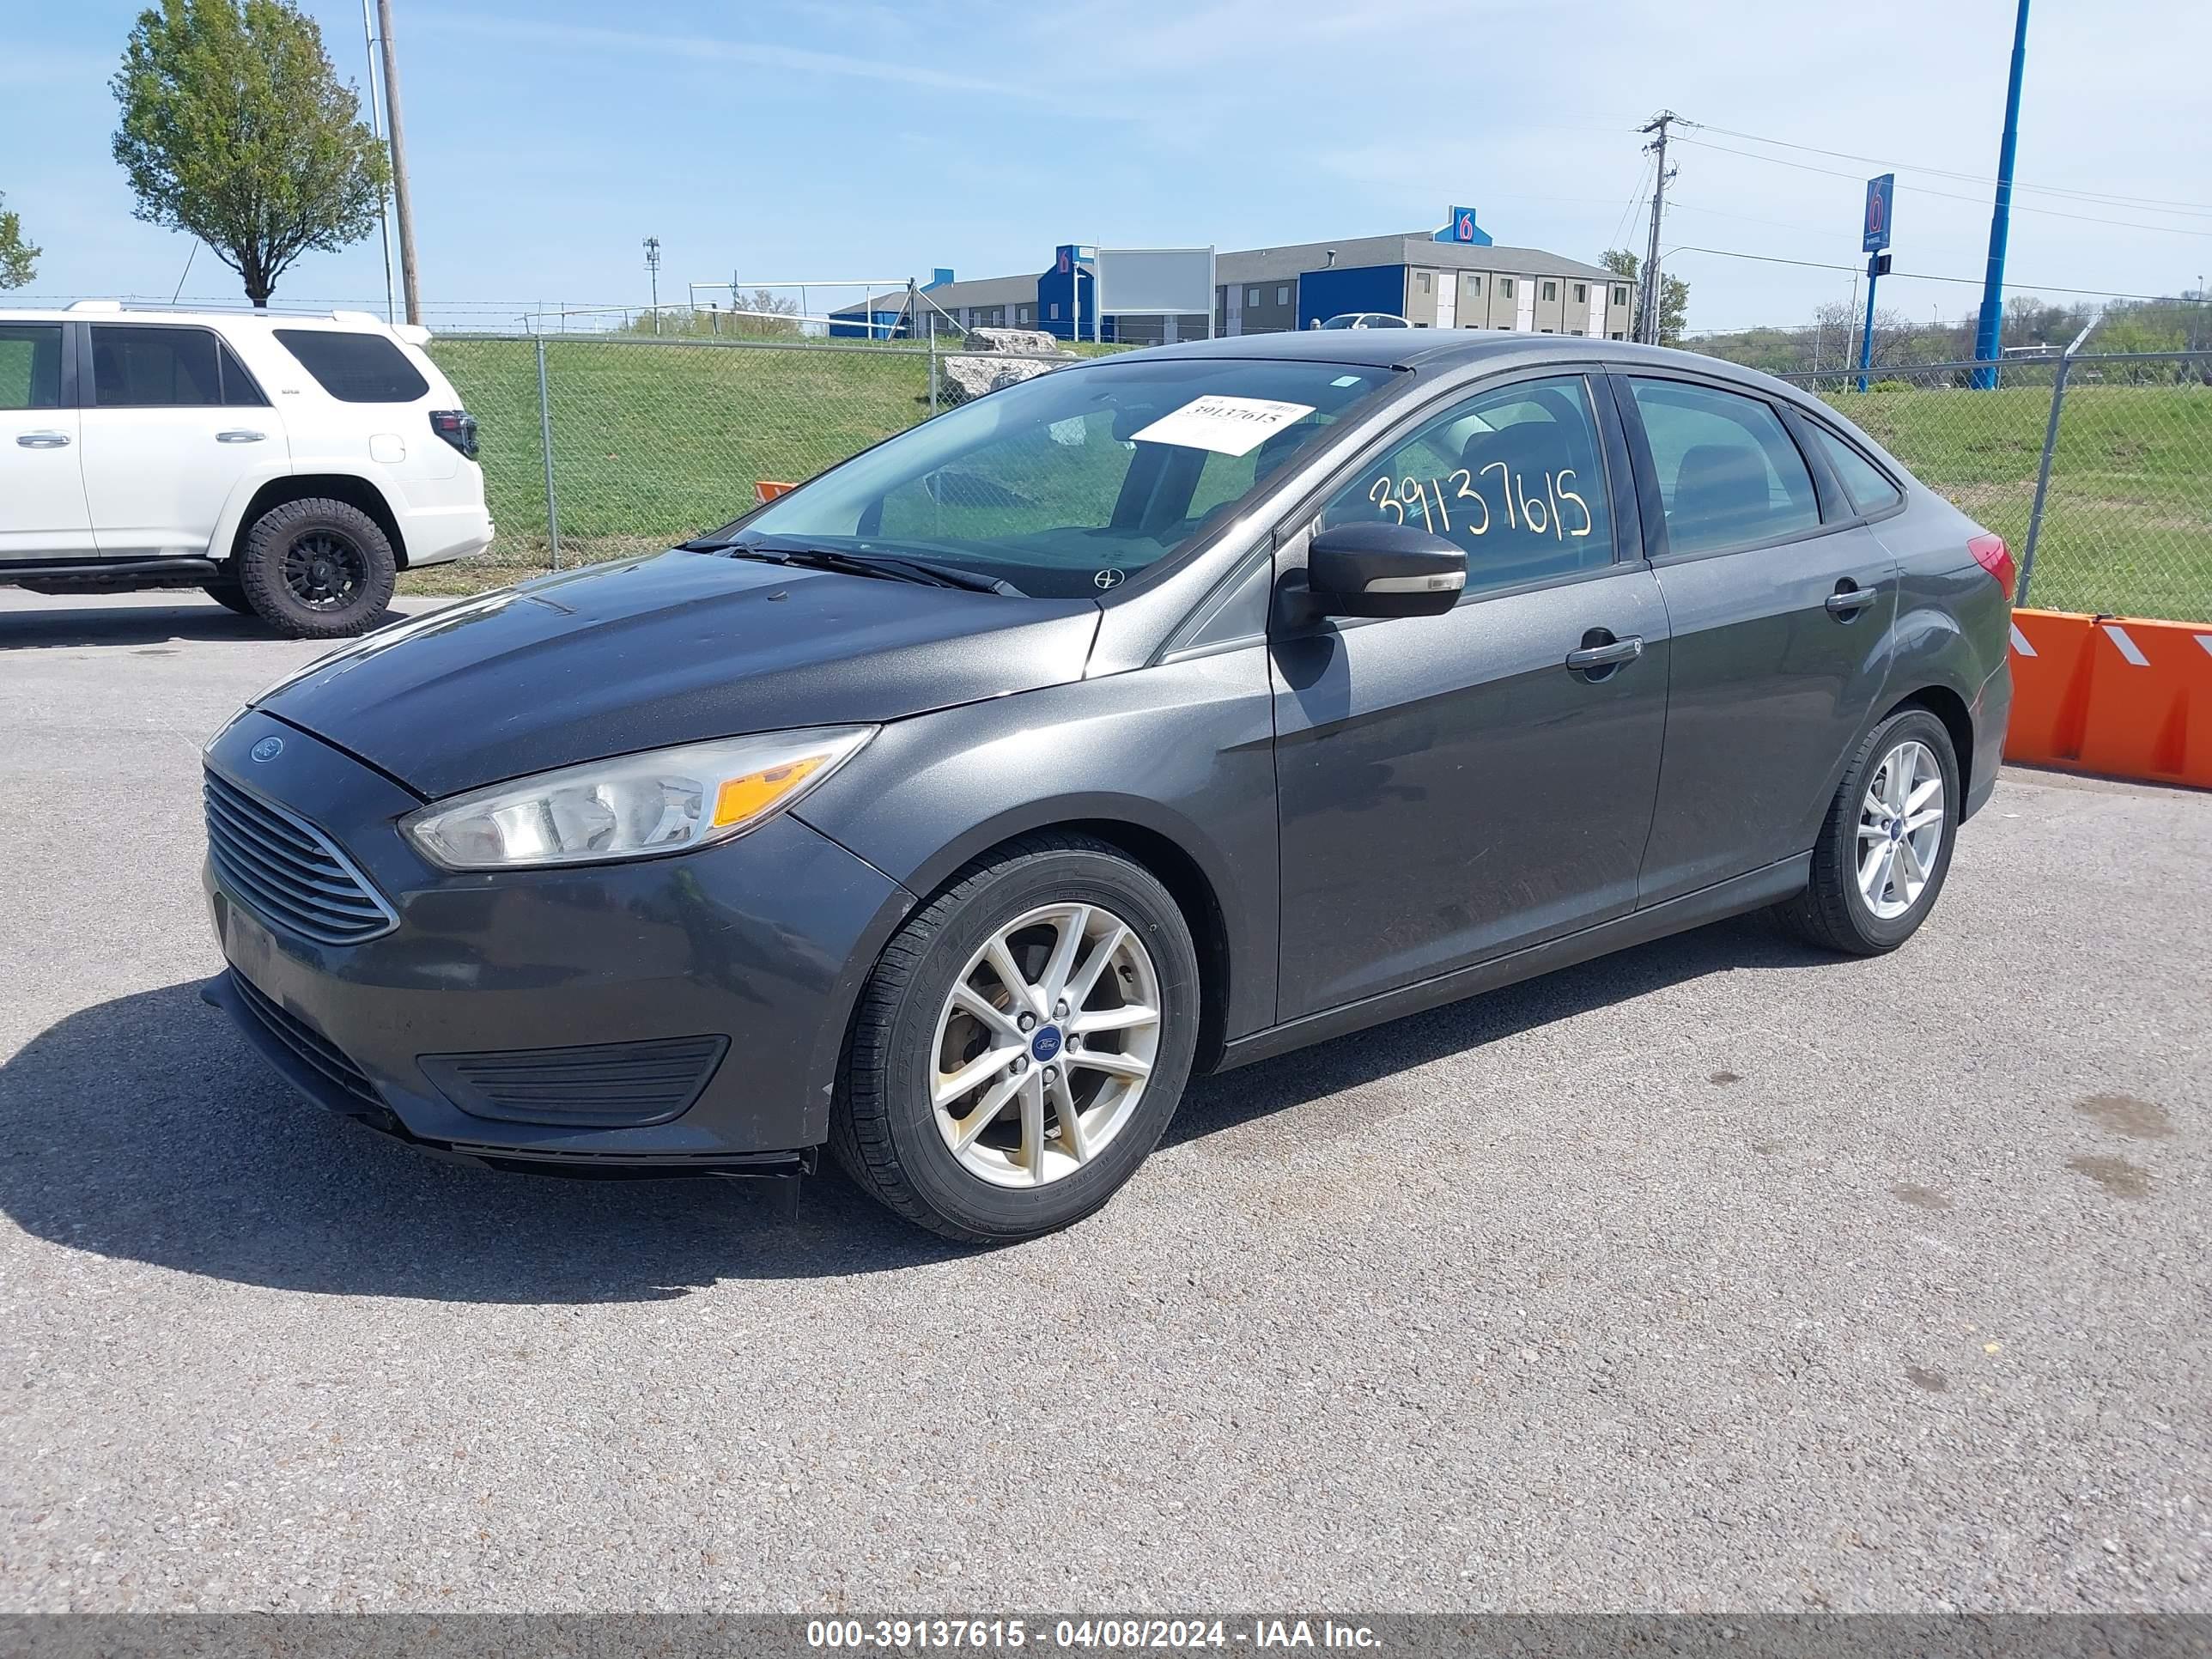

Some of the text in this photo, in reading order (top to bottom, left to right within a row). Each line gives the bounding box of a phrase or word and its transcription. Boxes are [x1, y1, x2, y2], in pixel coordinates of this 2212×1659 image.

[1868, 178, 1883, 233] 6
[1460, 213, 1474, 240] 6
[1059, 250, 1069, 273] 6
[1186, 405, 1284, 424] 39137615
[1369, 461, 1591, 542] 39137615
